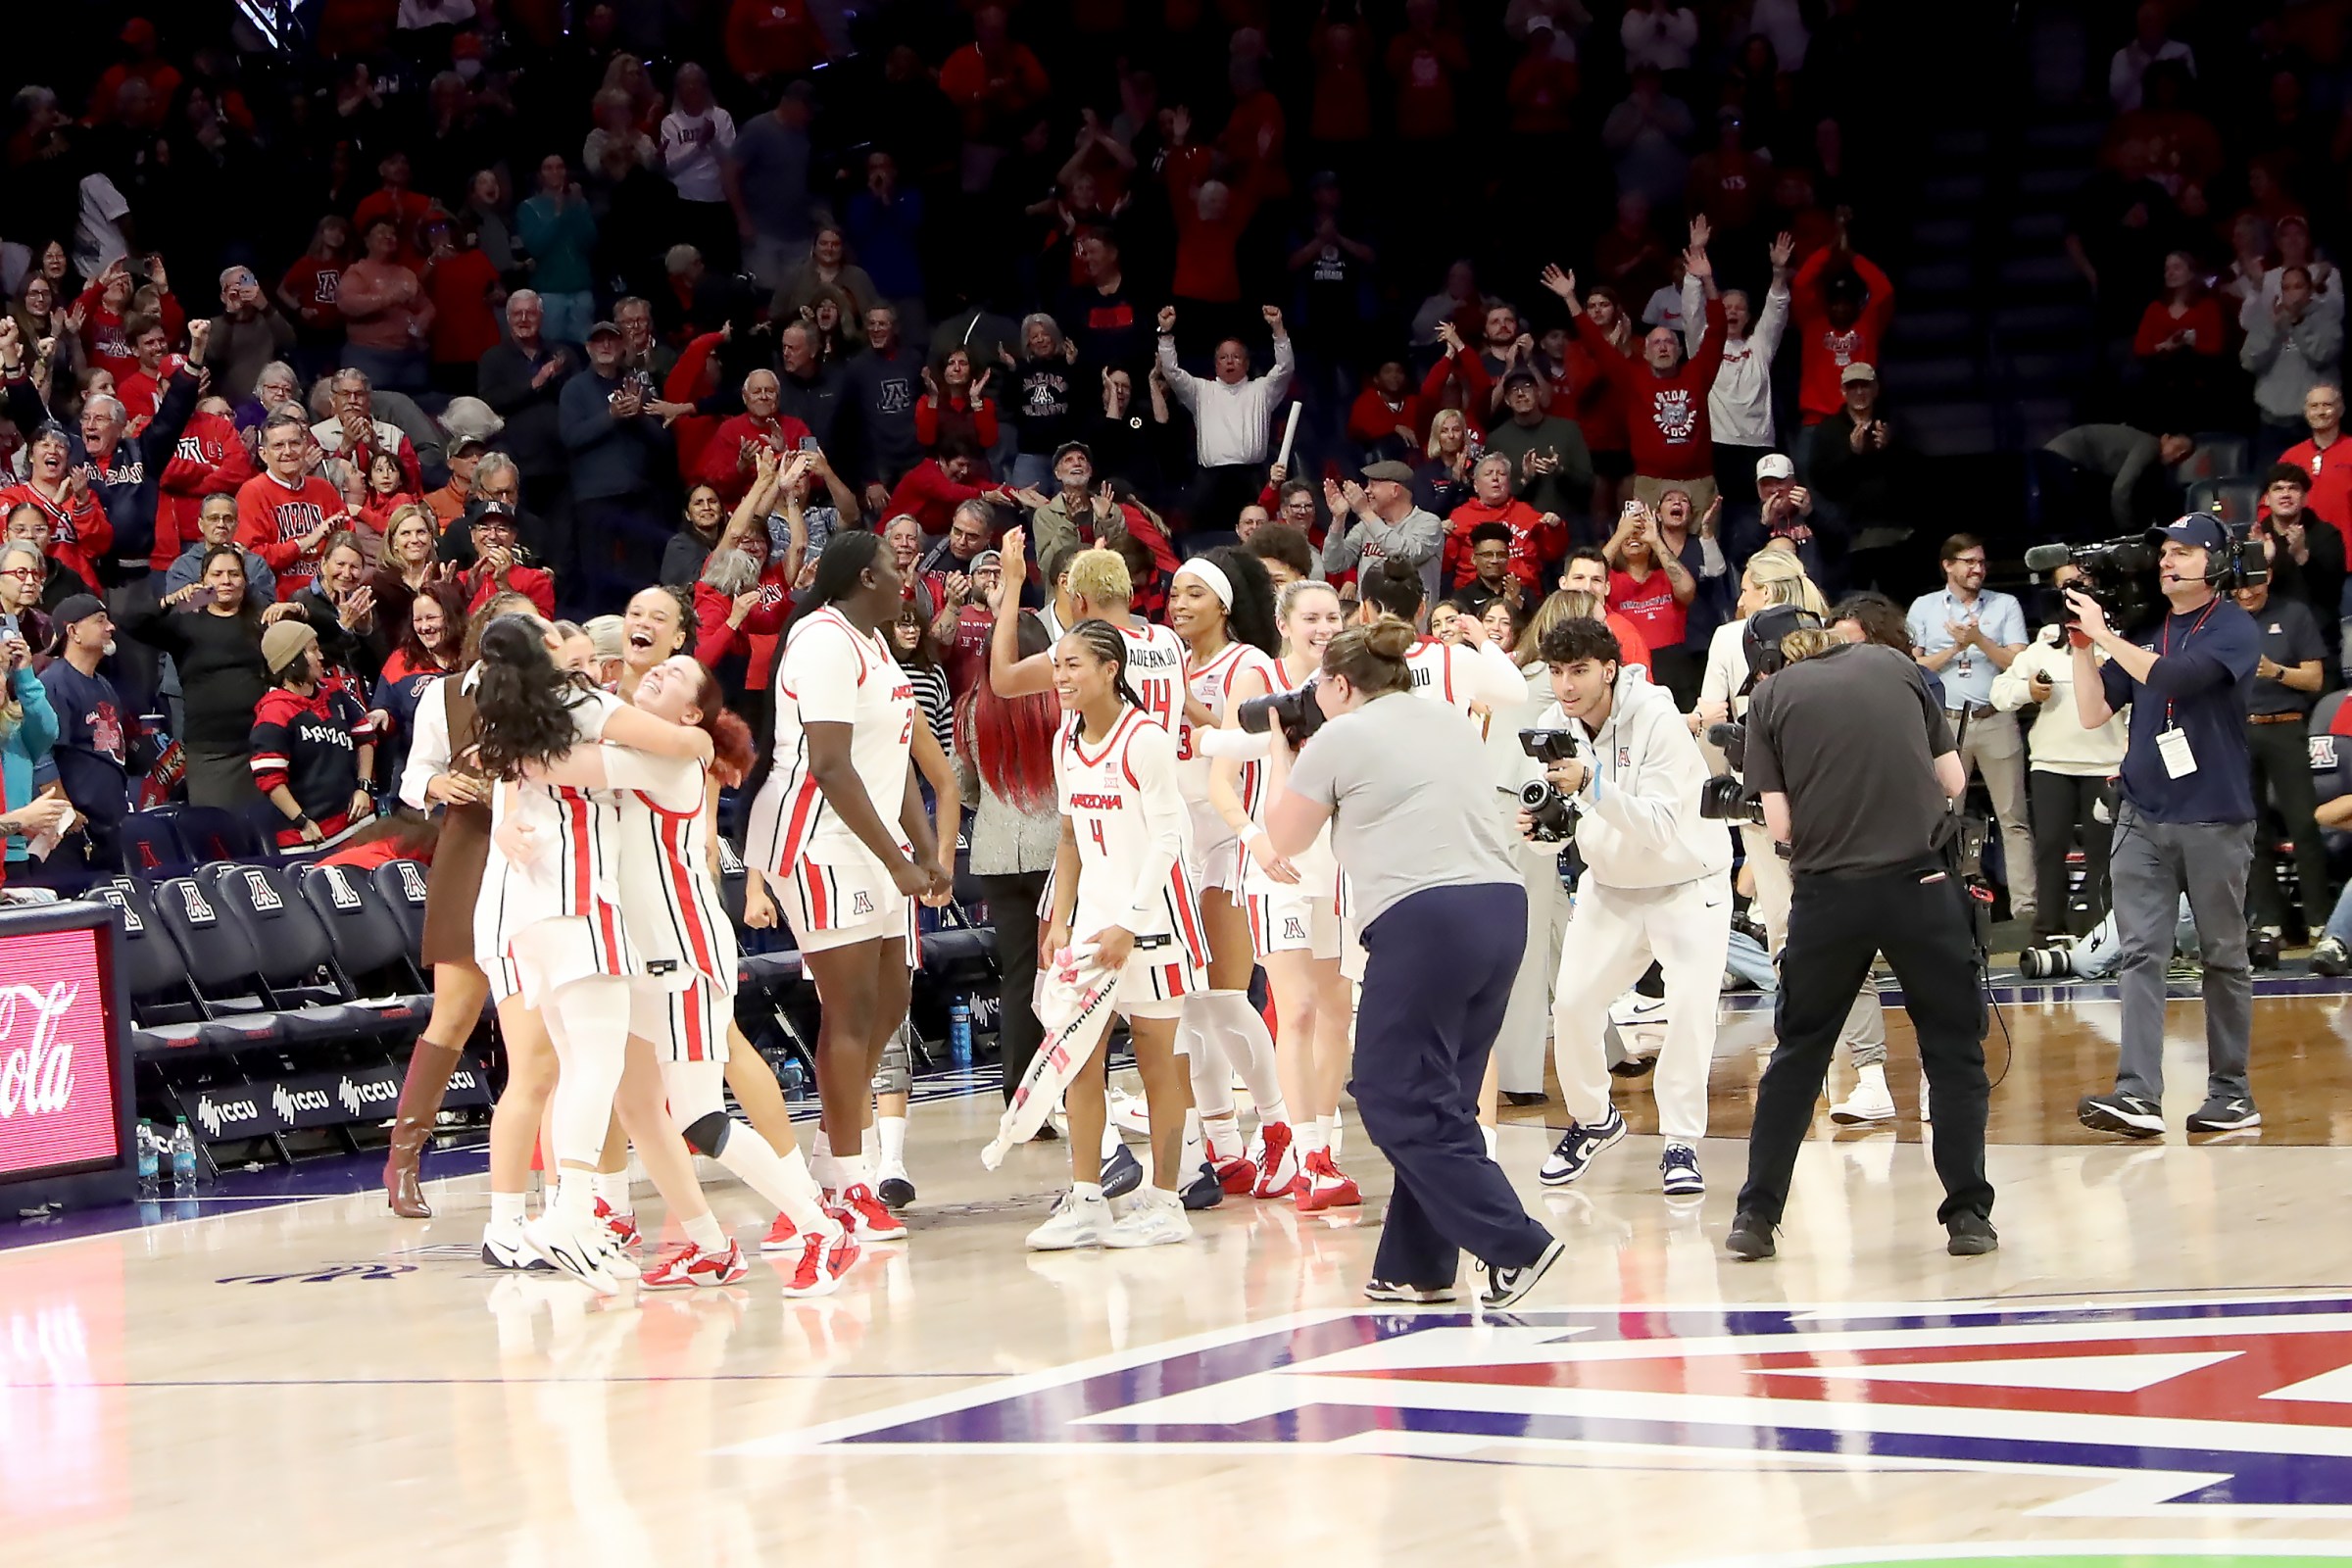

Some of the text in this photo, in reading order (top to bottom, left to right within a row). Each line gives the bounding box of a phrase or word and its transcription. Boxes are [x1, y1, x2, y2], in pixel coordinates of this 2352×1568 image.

[877, 378, 910, 414] A
[1142, 678, 1172, 730] 14
[1617, 747, 1631, 767] A
[2309, 735, 2338, 769] A
[1070, 793, 1123, 810] ARIZONA
[1090, 818, 1107, 857] 4
[178, 879, 217, 922] A
[243, 871, 283, 911] A
[854, 891, 874, 915] A
[1284, 917, 1306, 939] A
[217, 1100, 259, 1123] ICCU
[290, 1089, 330, 1111] ICCU
